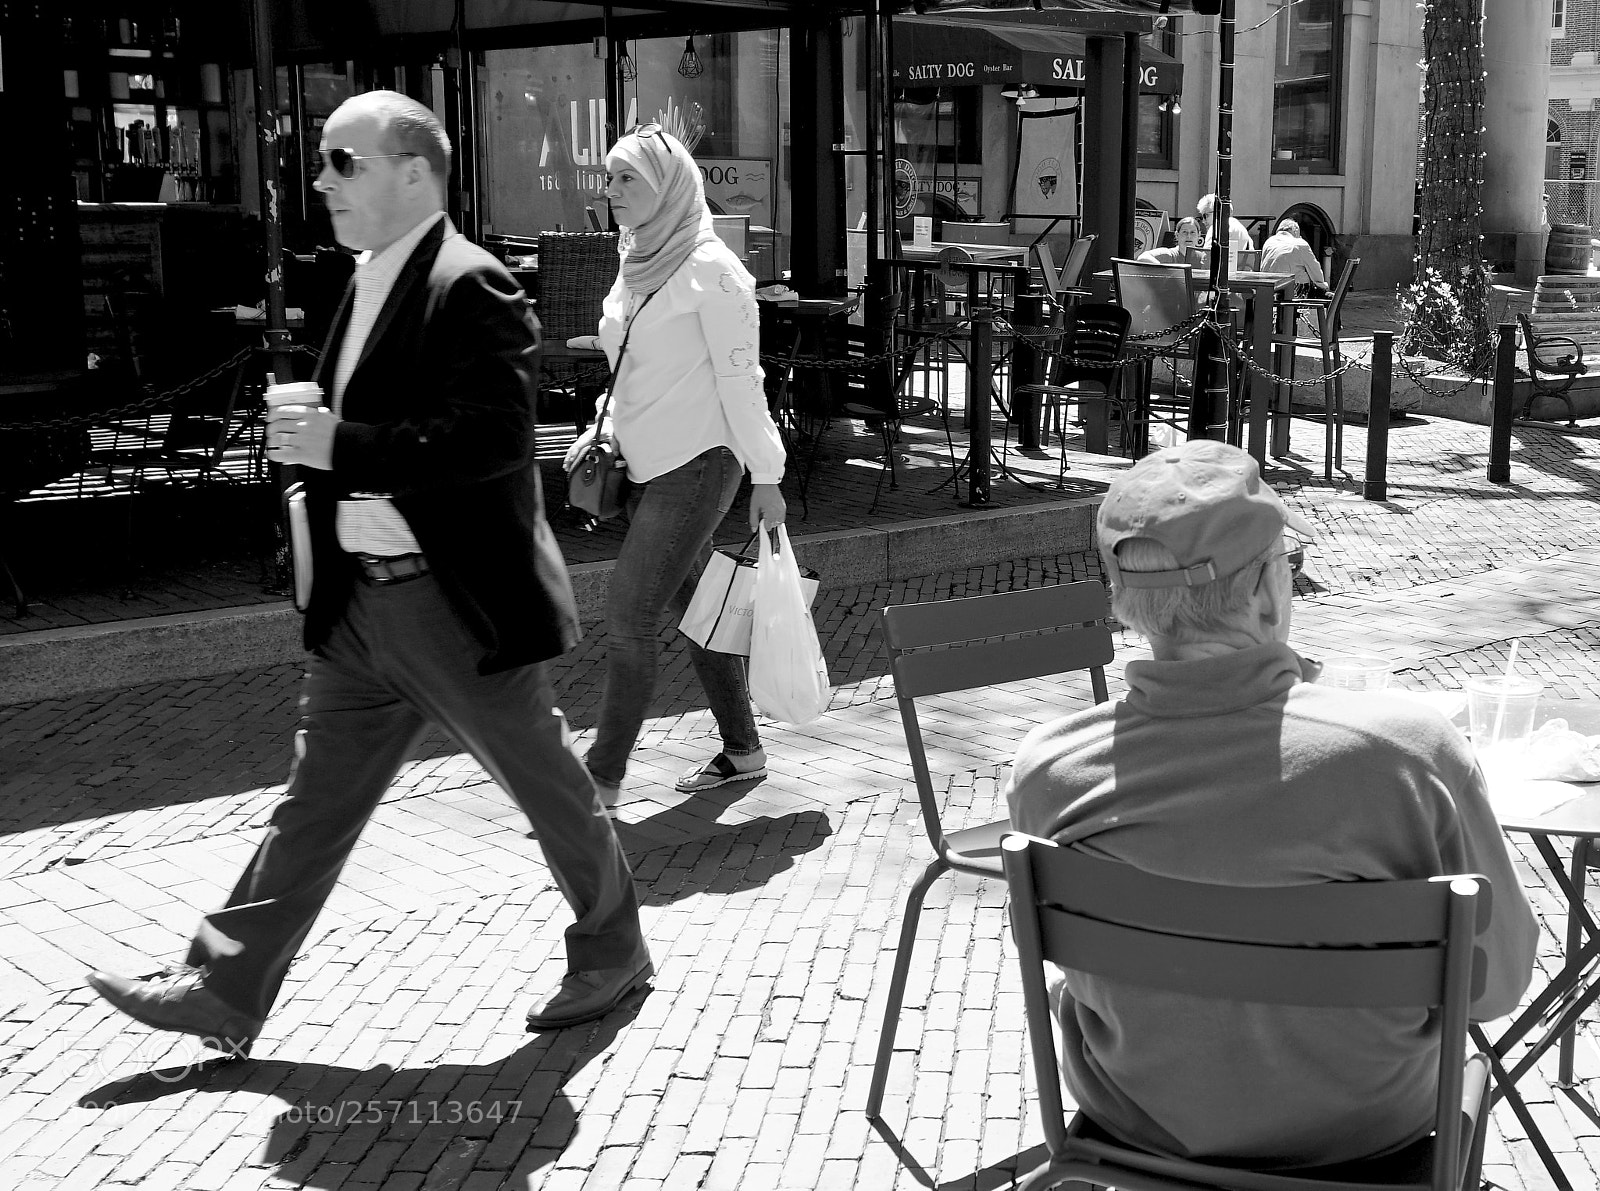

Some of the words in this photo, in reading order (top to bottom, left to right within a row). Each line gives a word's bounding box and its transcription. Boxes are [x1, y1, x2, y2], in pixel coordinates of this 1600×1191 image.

[908, 64, 943, 80] SALTY
[947, 62, 975, 78] DOG
[983, 64, 1001, 74] Oyster
[1003, 63, 1014, 72] Bar
[1052, 58, 1086, 81] SAL
[937, 181, 960, 192] DOG
[729, 605, 754, 618] VICTO
